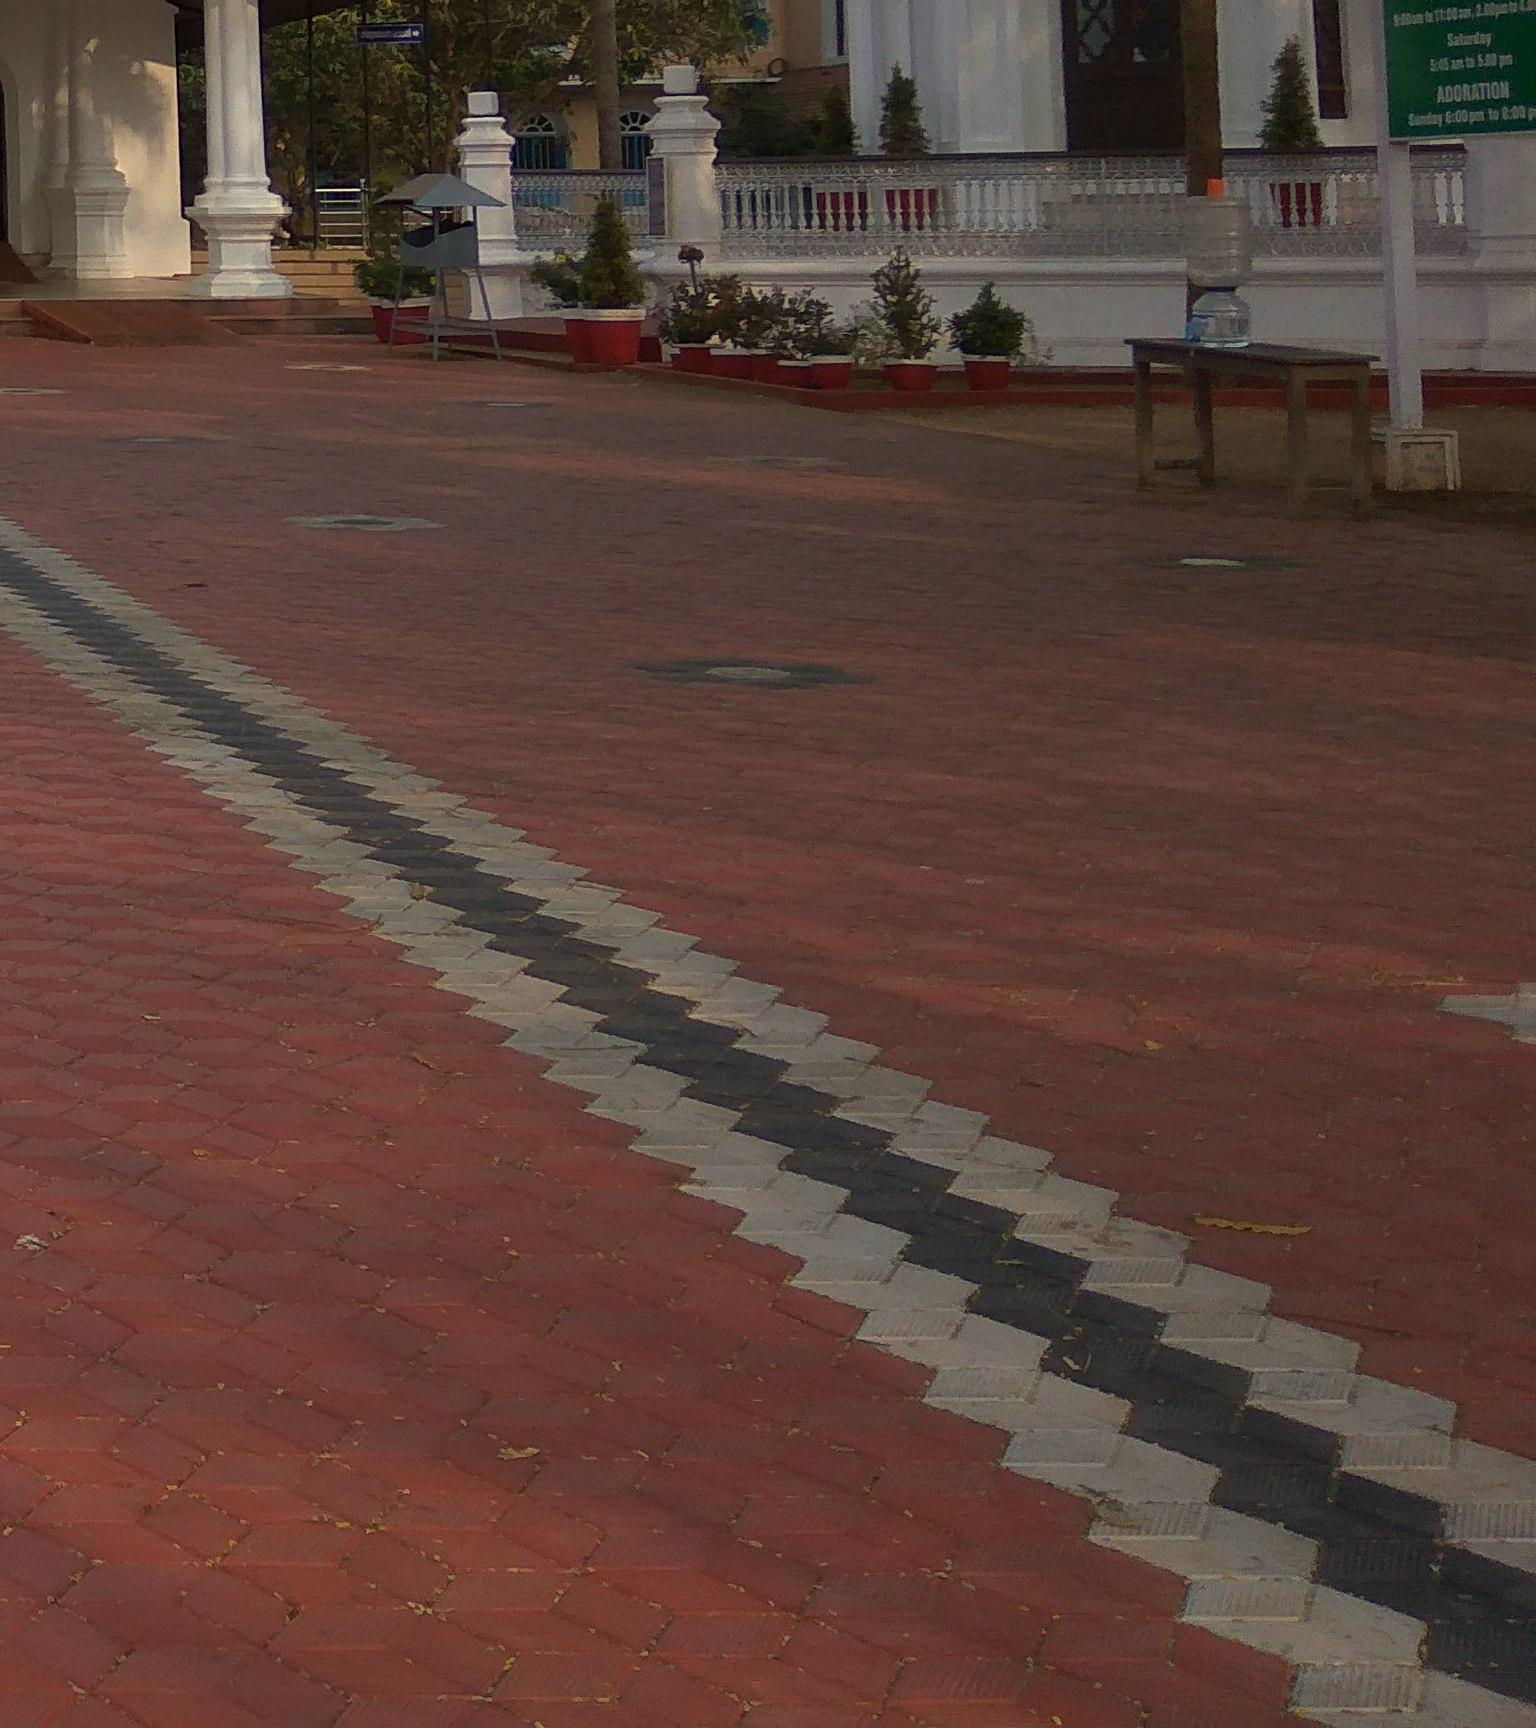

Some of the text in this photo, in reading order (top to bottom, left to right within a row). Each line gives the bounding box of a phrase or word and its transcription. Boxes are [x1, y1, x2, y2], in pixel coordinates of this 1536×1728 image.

[1447, 32, 1492, 47] Saturday
[1465, 57, 1475, 68] to
[1437, 81, 1509, 104] ADORATION
[1408, 112, 1443, 127] Sunday
[1468, 111, 1485, 124] pm
[1488, 108, 1499, 121] to
